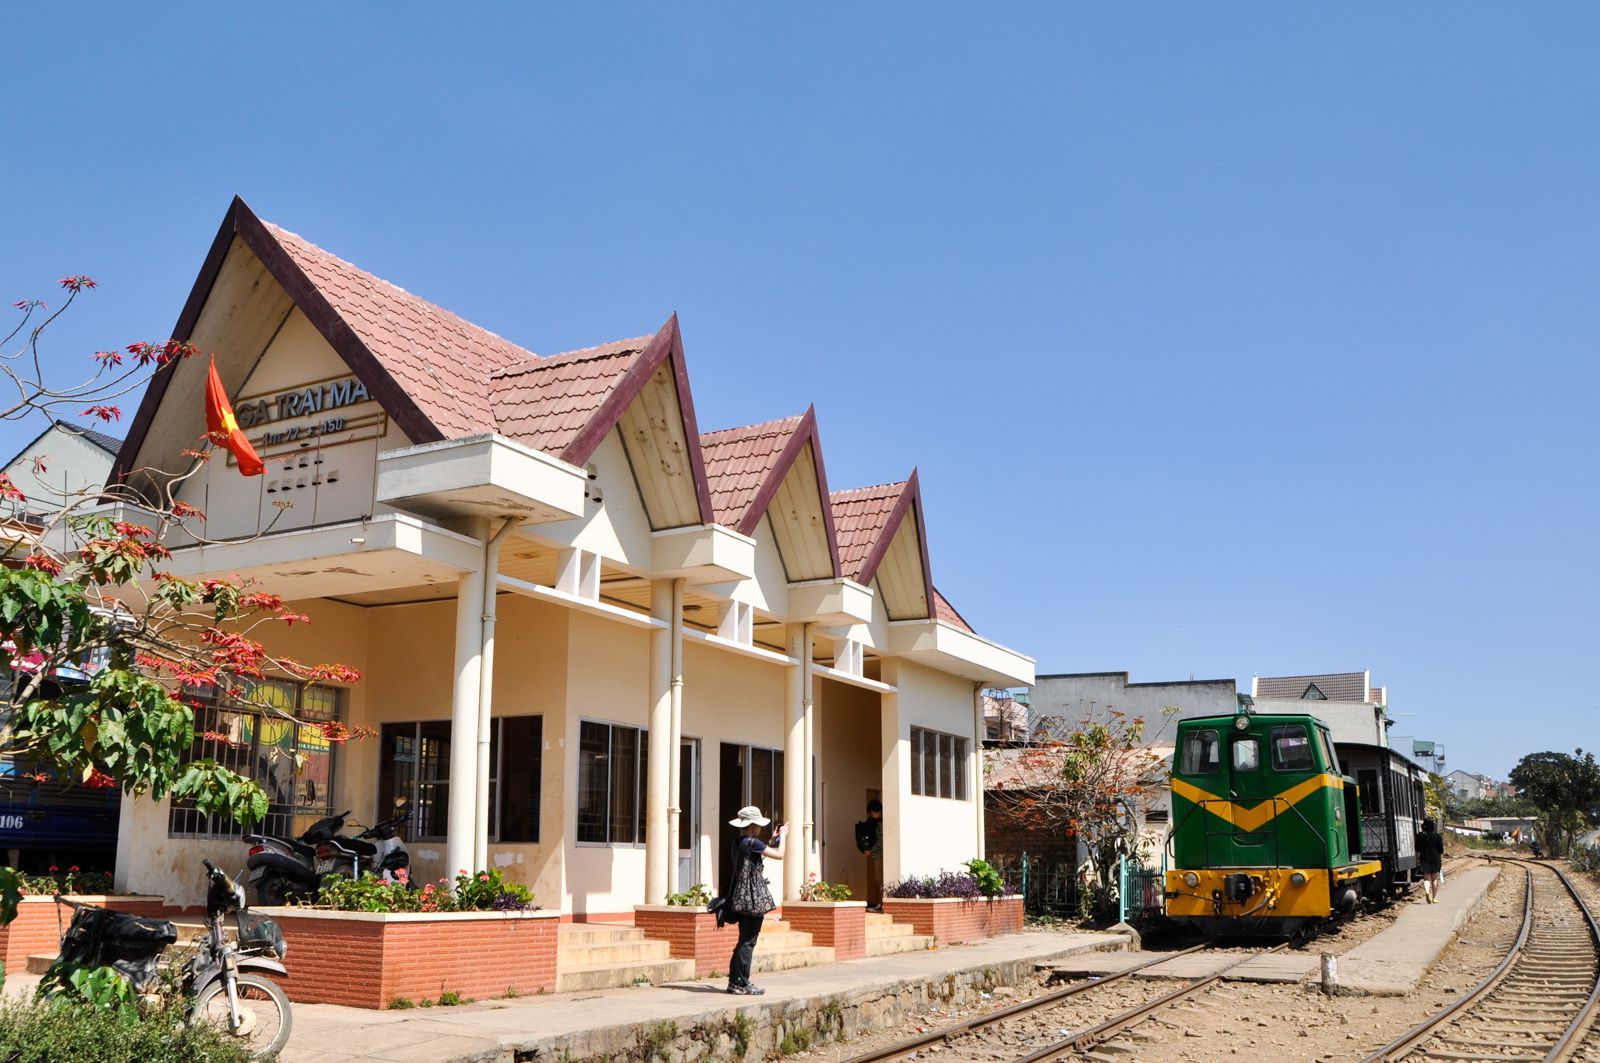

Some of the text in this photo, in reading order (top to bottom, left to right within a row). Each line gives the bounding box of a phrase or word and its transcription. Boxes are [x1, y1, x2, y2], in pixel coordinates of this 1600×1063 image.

[236, 378, 375, 428] GA TRAI MA
[287, 427, 300, 441] 77
[319, 417, 344, 434] 450
